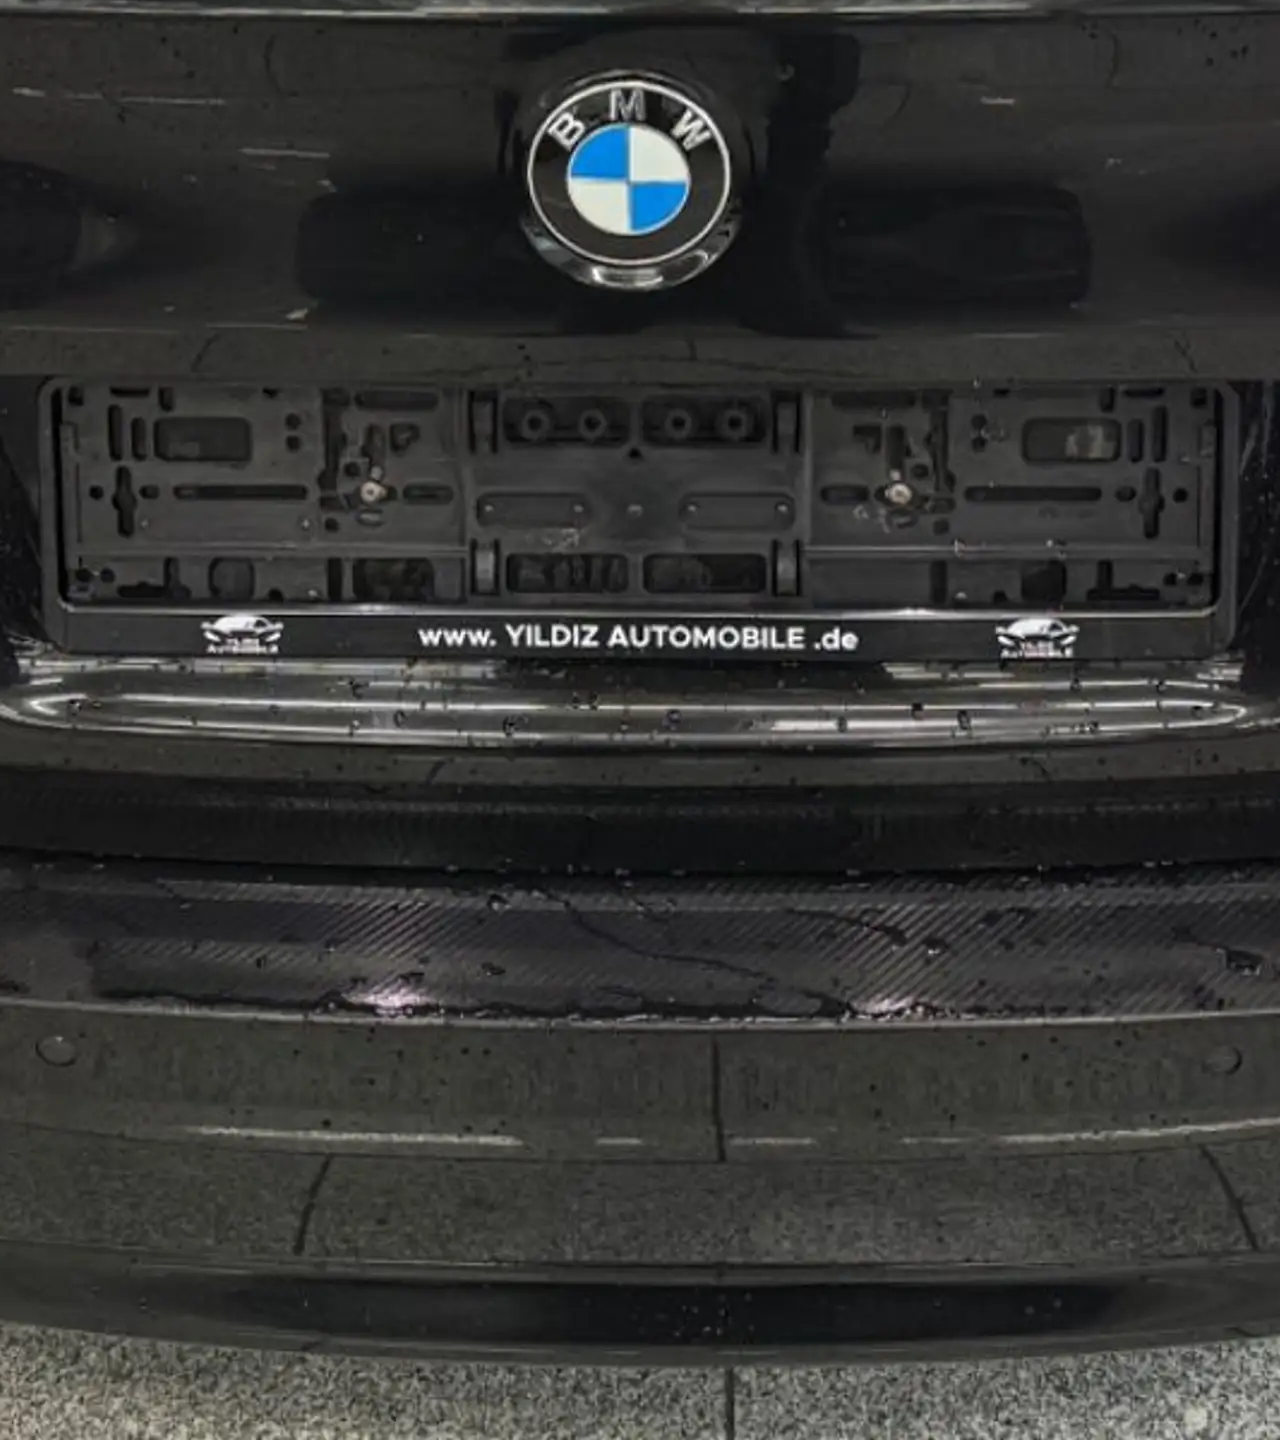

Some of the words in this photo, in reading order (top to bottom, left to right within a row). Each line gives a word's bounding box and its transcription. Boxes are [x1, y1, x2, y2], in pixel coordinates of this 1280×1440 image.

[547, 89, 711, 152] BMW
[417, 627, 497, 648] www.
[505, 623, 600, 648] YILDIZ
[607, 624, 805, 650] AUTOMOBILE
[813, 626, 860, 651] .de
